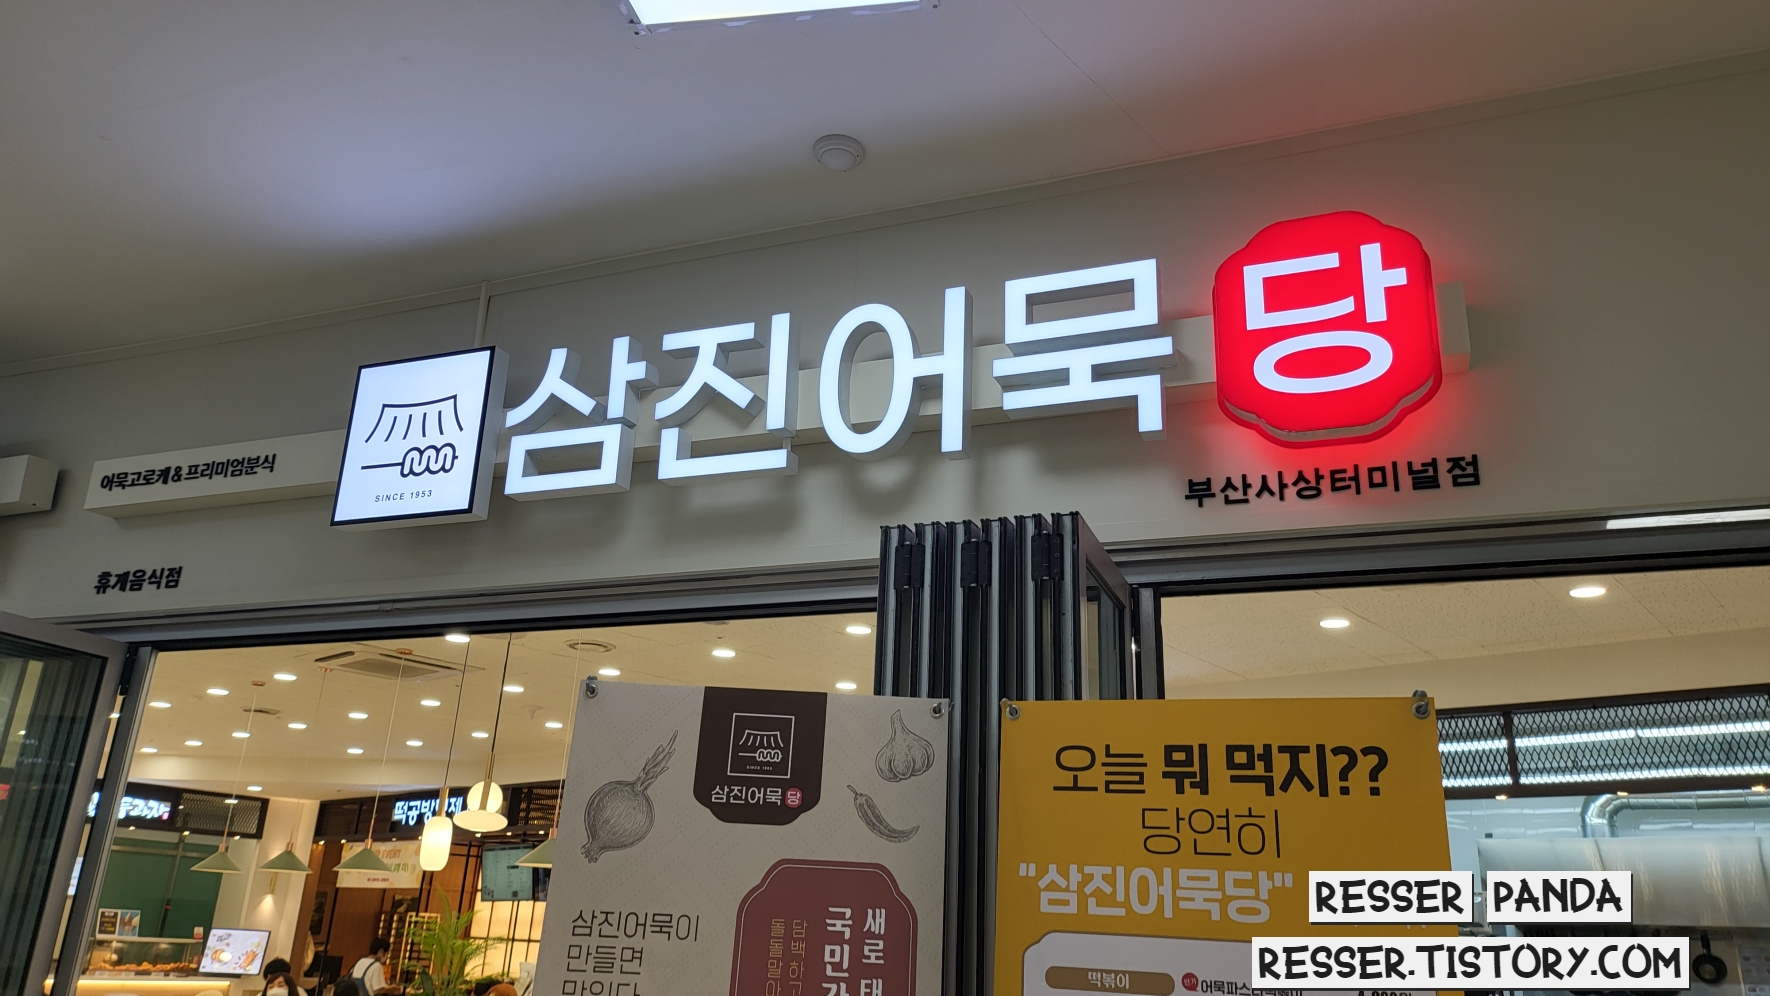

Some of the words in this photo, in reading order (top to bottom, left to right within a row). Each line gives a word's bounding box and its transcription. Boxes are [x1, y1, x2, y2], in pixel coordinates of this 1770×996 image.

[374, 492, 406, 503] SINCE
[409, 489, 433, 500] 1953
[1185, 454, 1481, 508] 부산사상터미널점
[94, 566, 183, 594] 휴게음식점
[1053, 744, 1147, 794] 오늘
[1162, 743, 1209, 795] 뭐
[1225, 743, 1389, 797] 먹지??
[1141, 807, 1281, 859] 당연히
[1018, 862, 1293, 923] "삼진어묵당"
[571, 909, 700, 942] 삼진어묵이
[862, 908, 886, 964] 새로
[566, 944, 643, 975] 만들면
